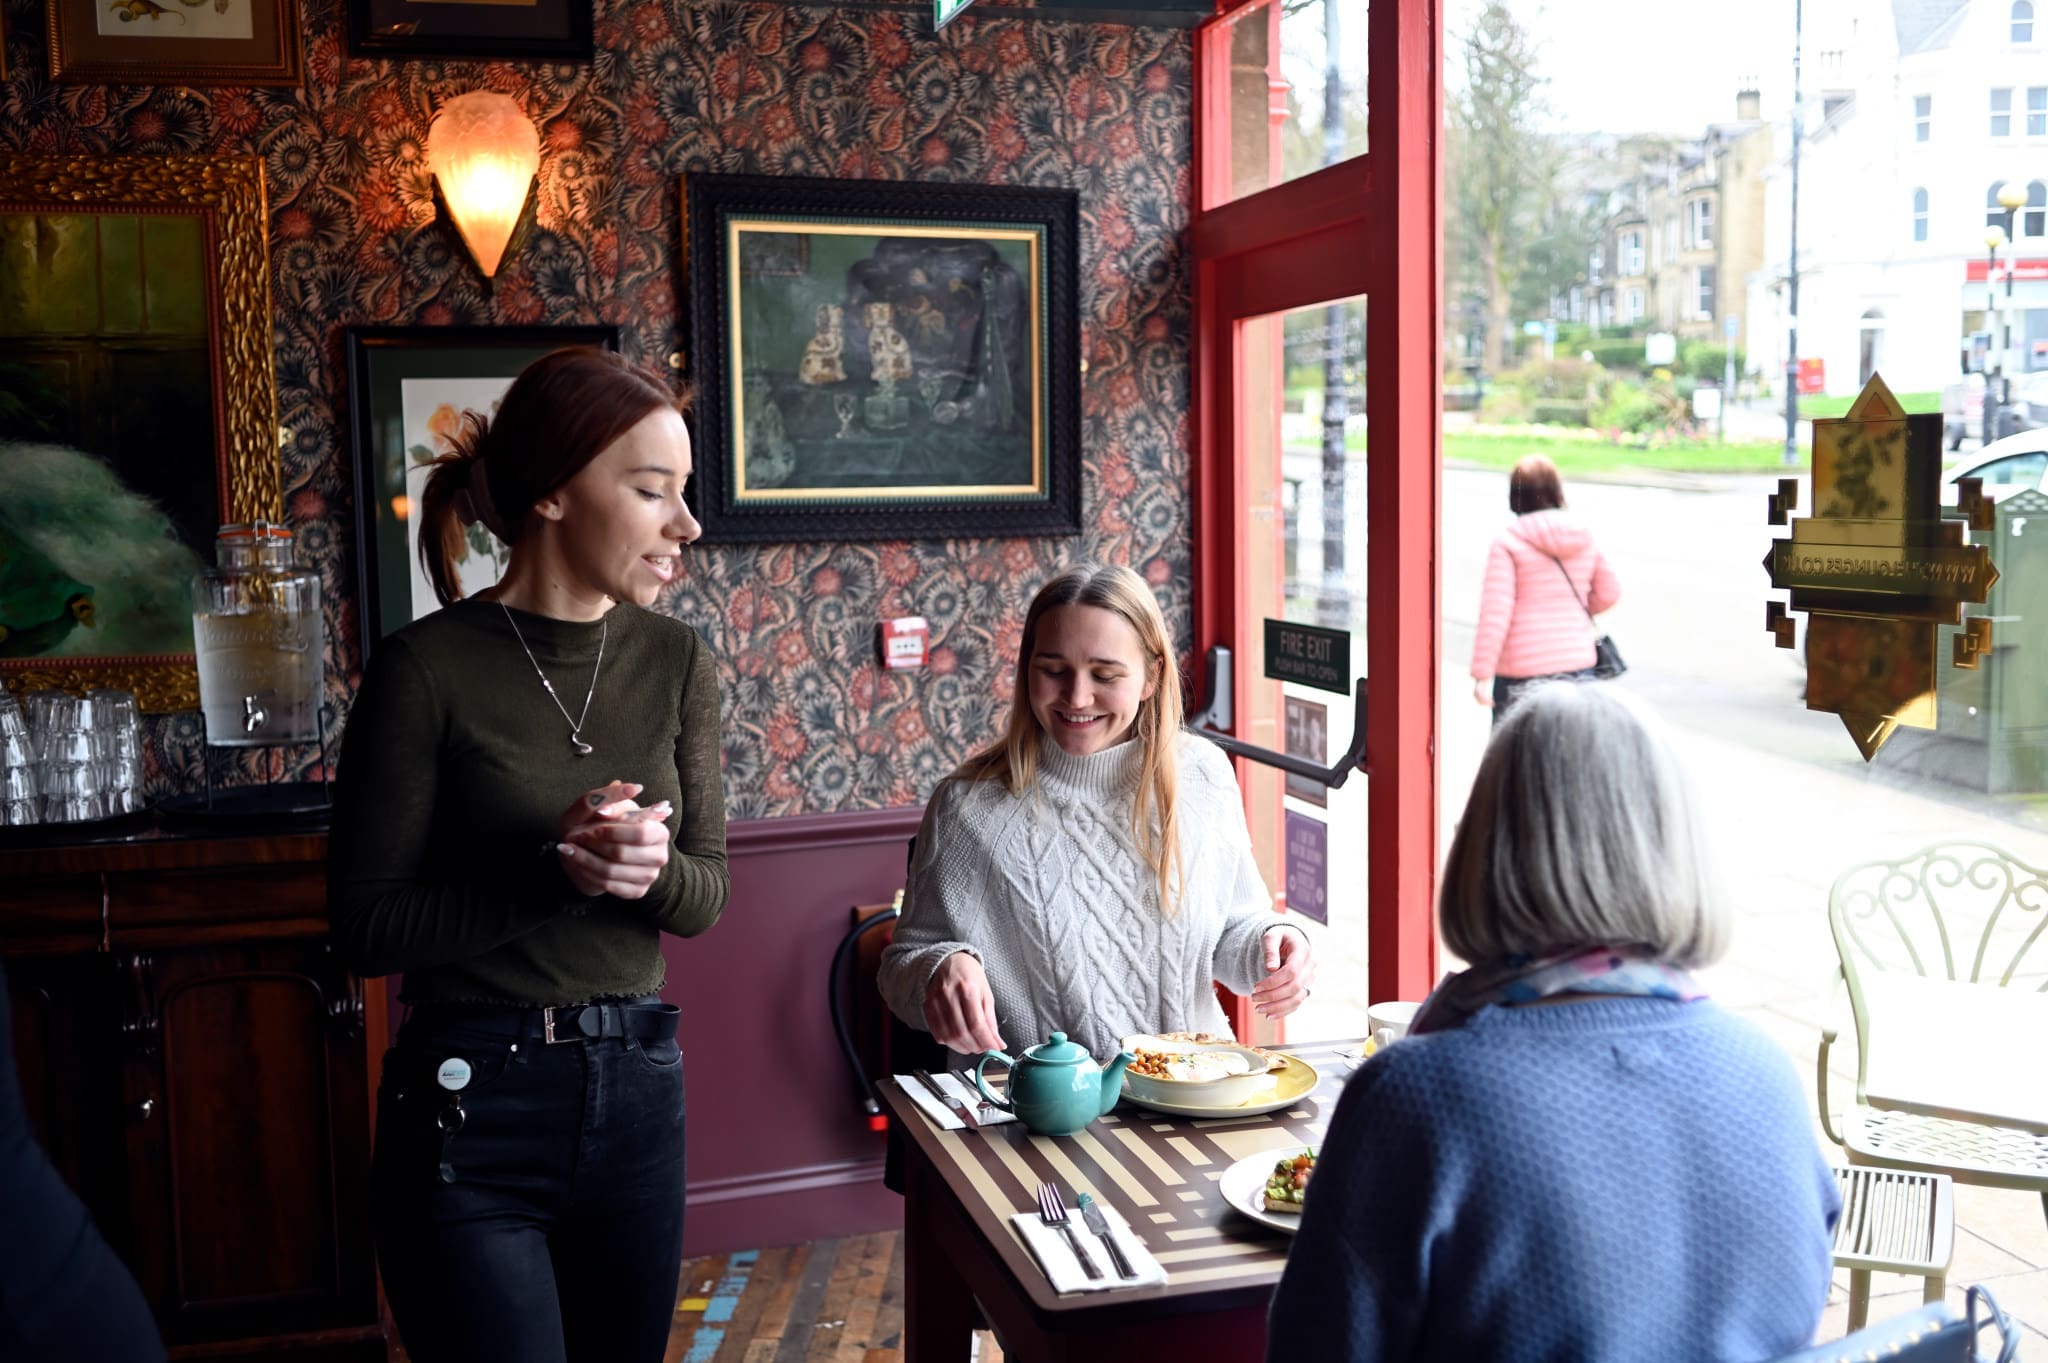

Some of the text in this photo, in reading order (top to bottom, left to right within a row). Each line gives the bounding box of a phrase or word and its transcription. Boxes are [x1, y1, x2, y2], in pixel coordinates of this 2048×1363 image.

[1280, 631, 1332, 662] FIRE EXIT
[1274, 656, 1338, 682] PUSH BAR TO OPEN
